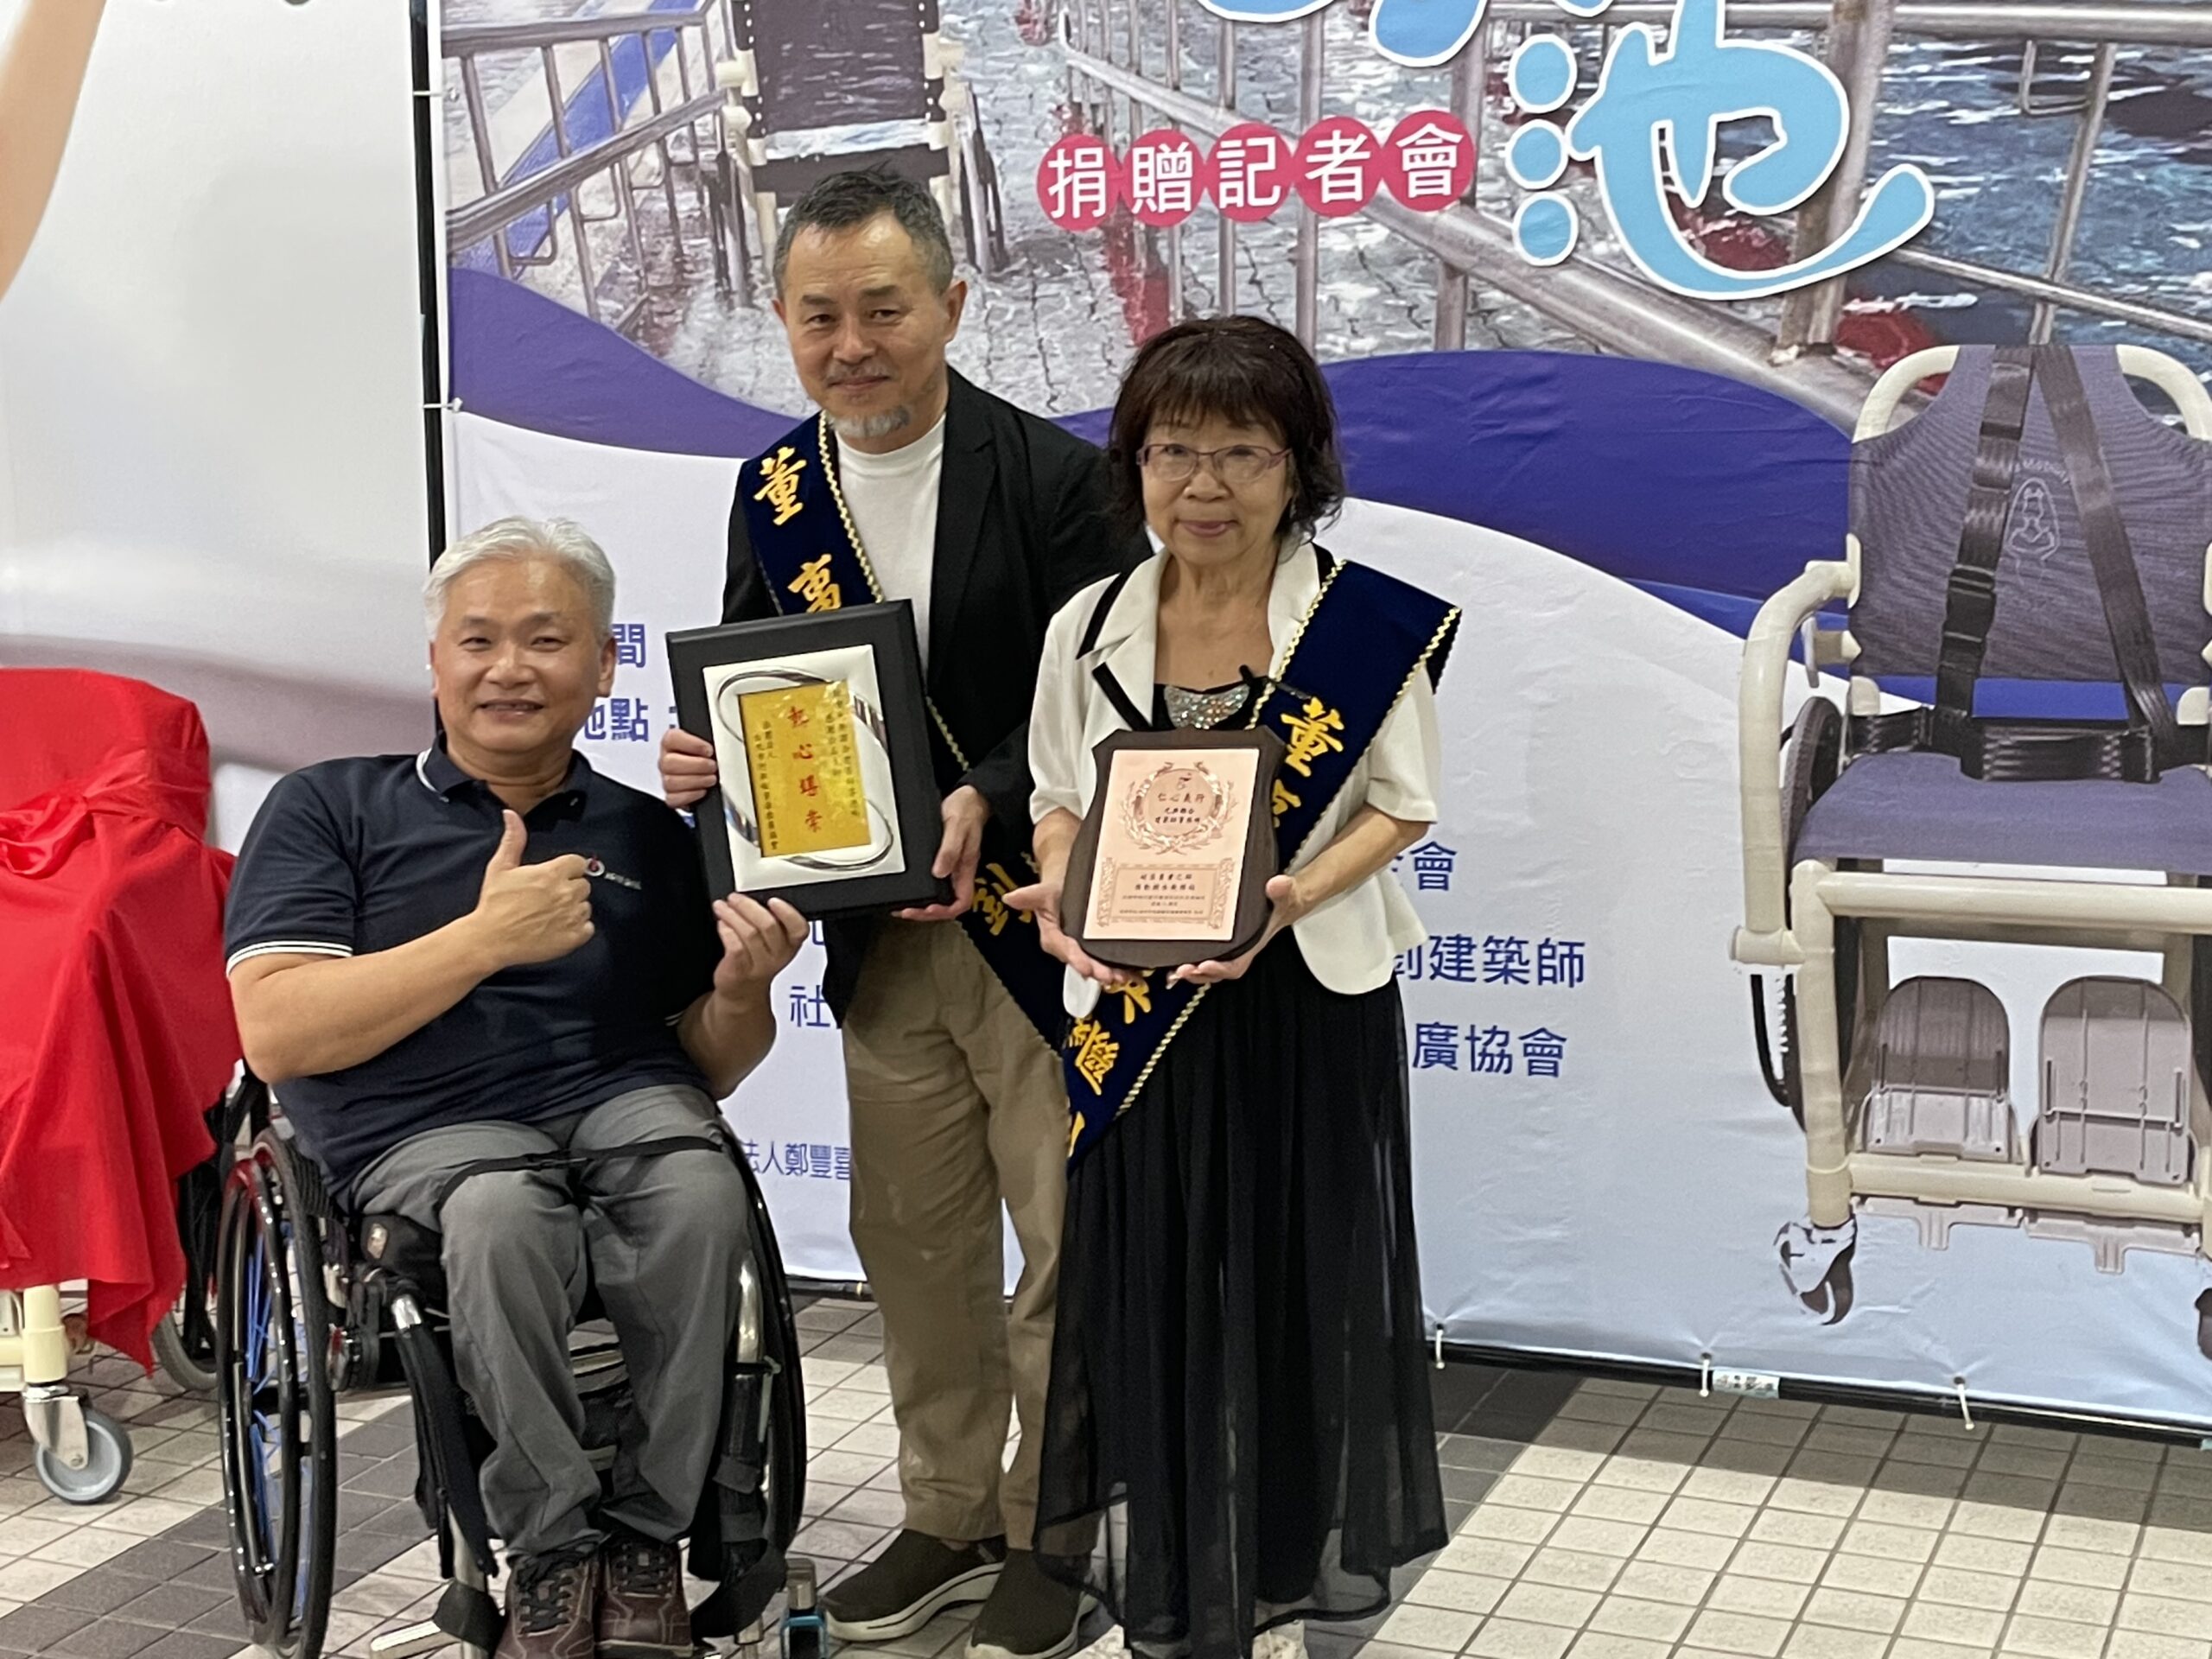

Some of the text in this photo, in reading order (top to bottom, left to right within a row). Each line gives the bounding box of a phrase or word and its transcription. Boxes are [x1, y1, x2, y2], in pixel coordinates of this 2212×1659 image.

[1046, 125, 1464, 219] 捐贈記者會
[1391, 841, 1458, 892] 會
[1412, 1021, 1567, 1078] 廣協會
